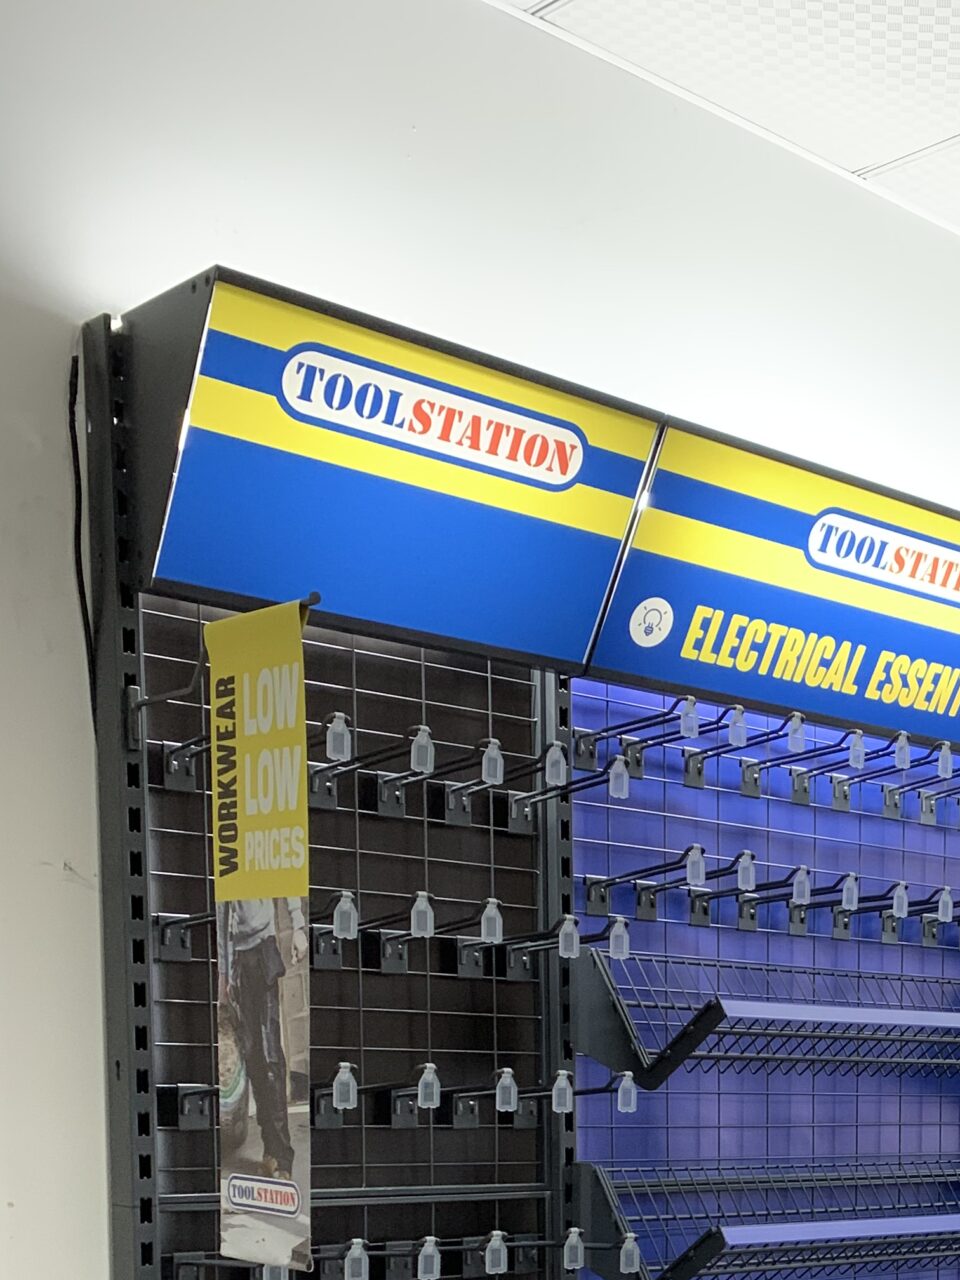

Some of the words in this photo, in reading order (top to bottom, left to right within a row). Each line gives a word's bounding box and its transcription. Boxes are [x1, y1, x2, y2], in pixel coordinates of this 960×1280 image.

[295, 361, 578, 476] TOOLSTATION
[680, 604, 866, 696] ELECTRICAL
[242, 662, 299, 737] LOW
[215, 674, 239, 878] WORKWEAR
[244, 745, 302, 816] LOW
[244, 826, 305, 872] PRICES
[231, 1183, 297, 1207] TOOLSTATION
